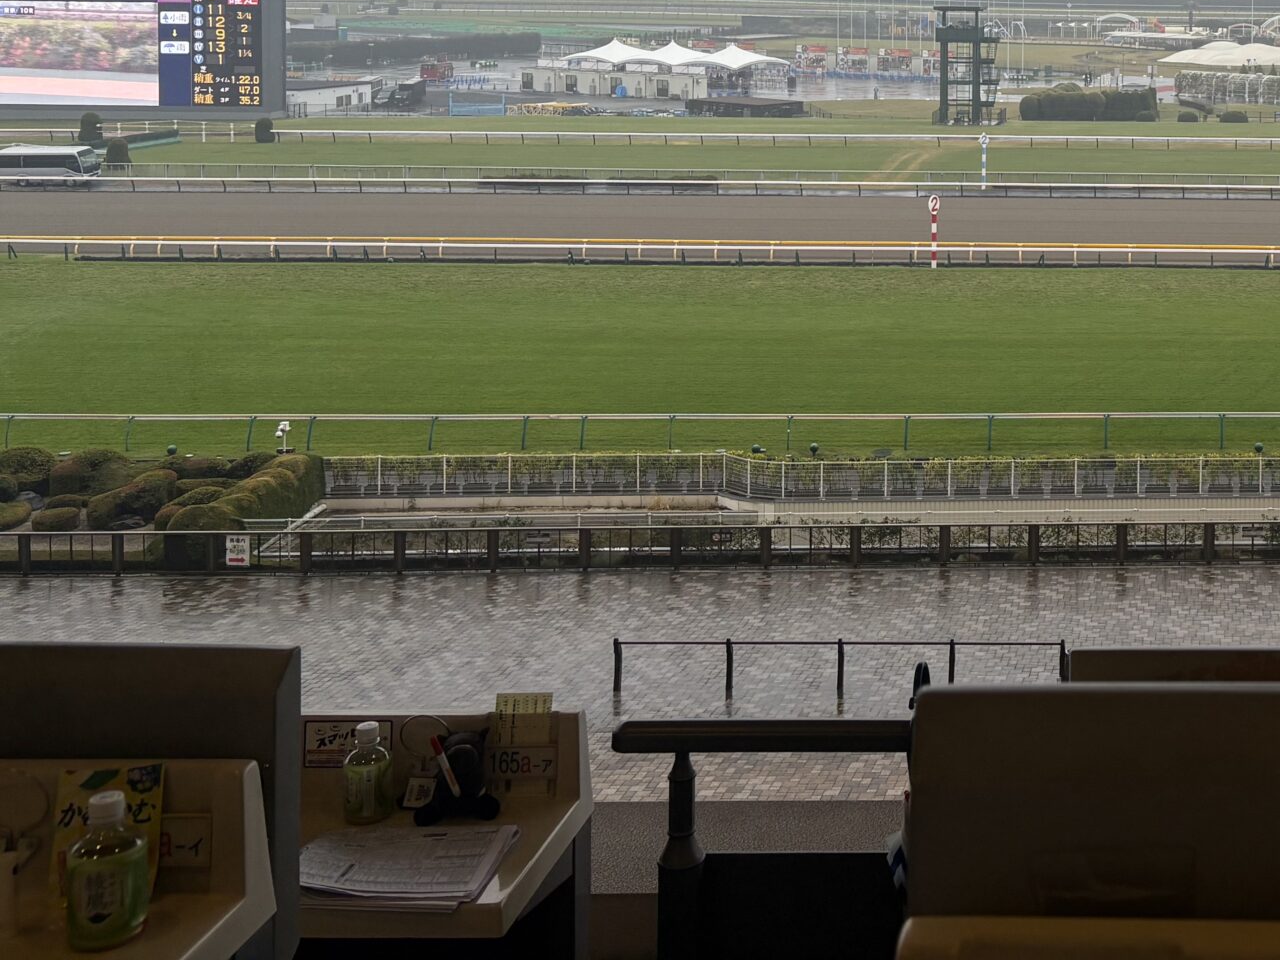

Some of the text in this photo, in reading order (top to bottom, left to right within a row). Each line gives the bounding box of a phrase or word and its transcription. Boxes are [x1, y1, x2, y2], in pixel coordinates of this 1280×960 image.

[207, 16, 225, 27] 12
[240, 24, 248, 33] 2
[215, 29, 226, 40] 9
[208, 41, 226, 53] 13
[231, 75, 260, 84] 1.22.0
[194, 86, 214, 94] ダート
[239, 86, 260, 94] 47.0
[239, 96, 260, 105] 35.2
[931, 197, 939, 212] 2
[57, 799, 156, 827] かむ
